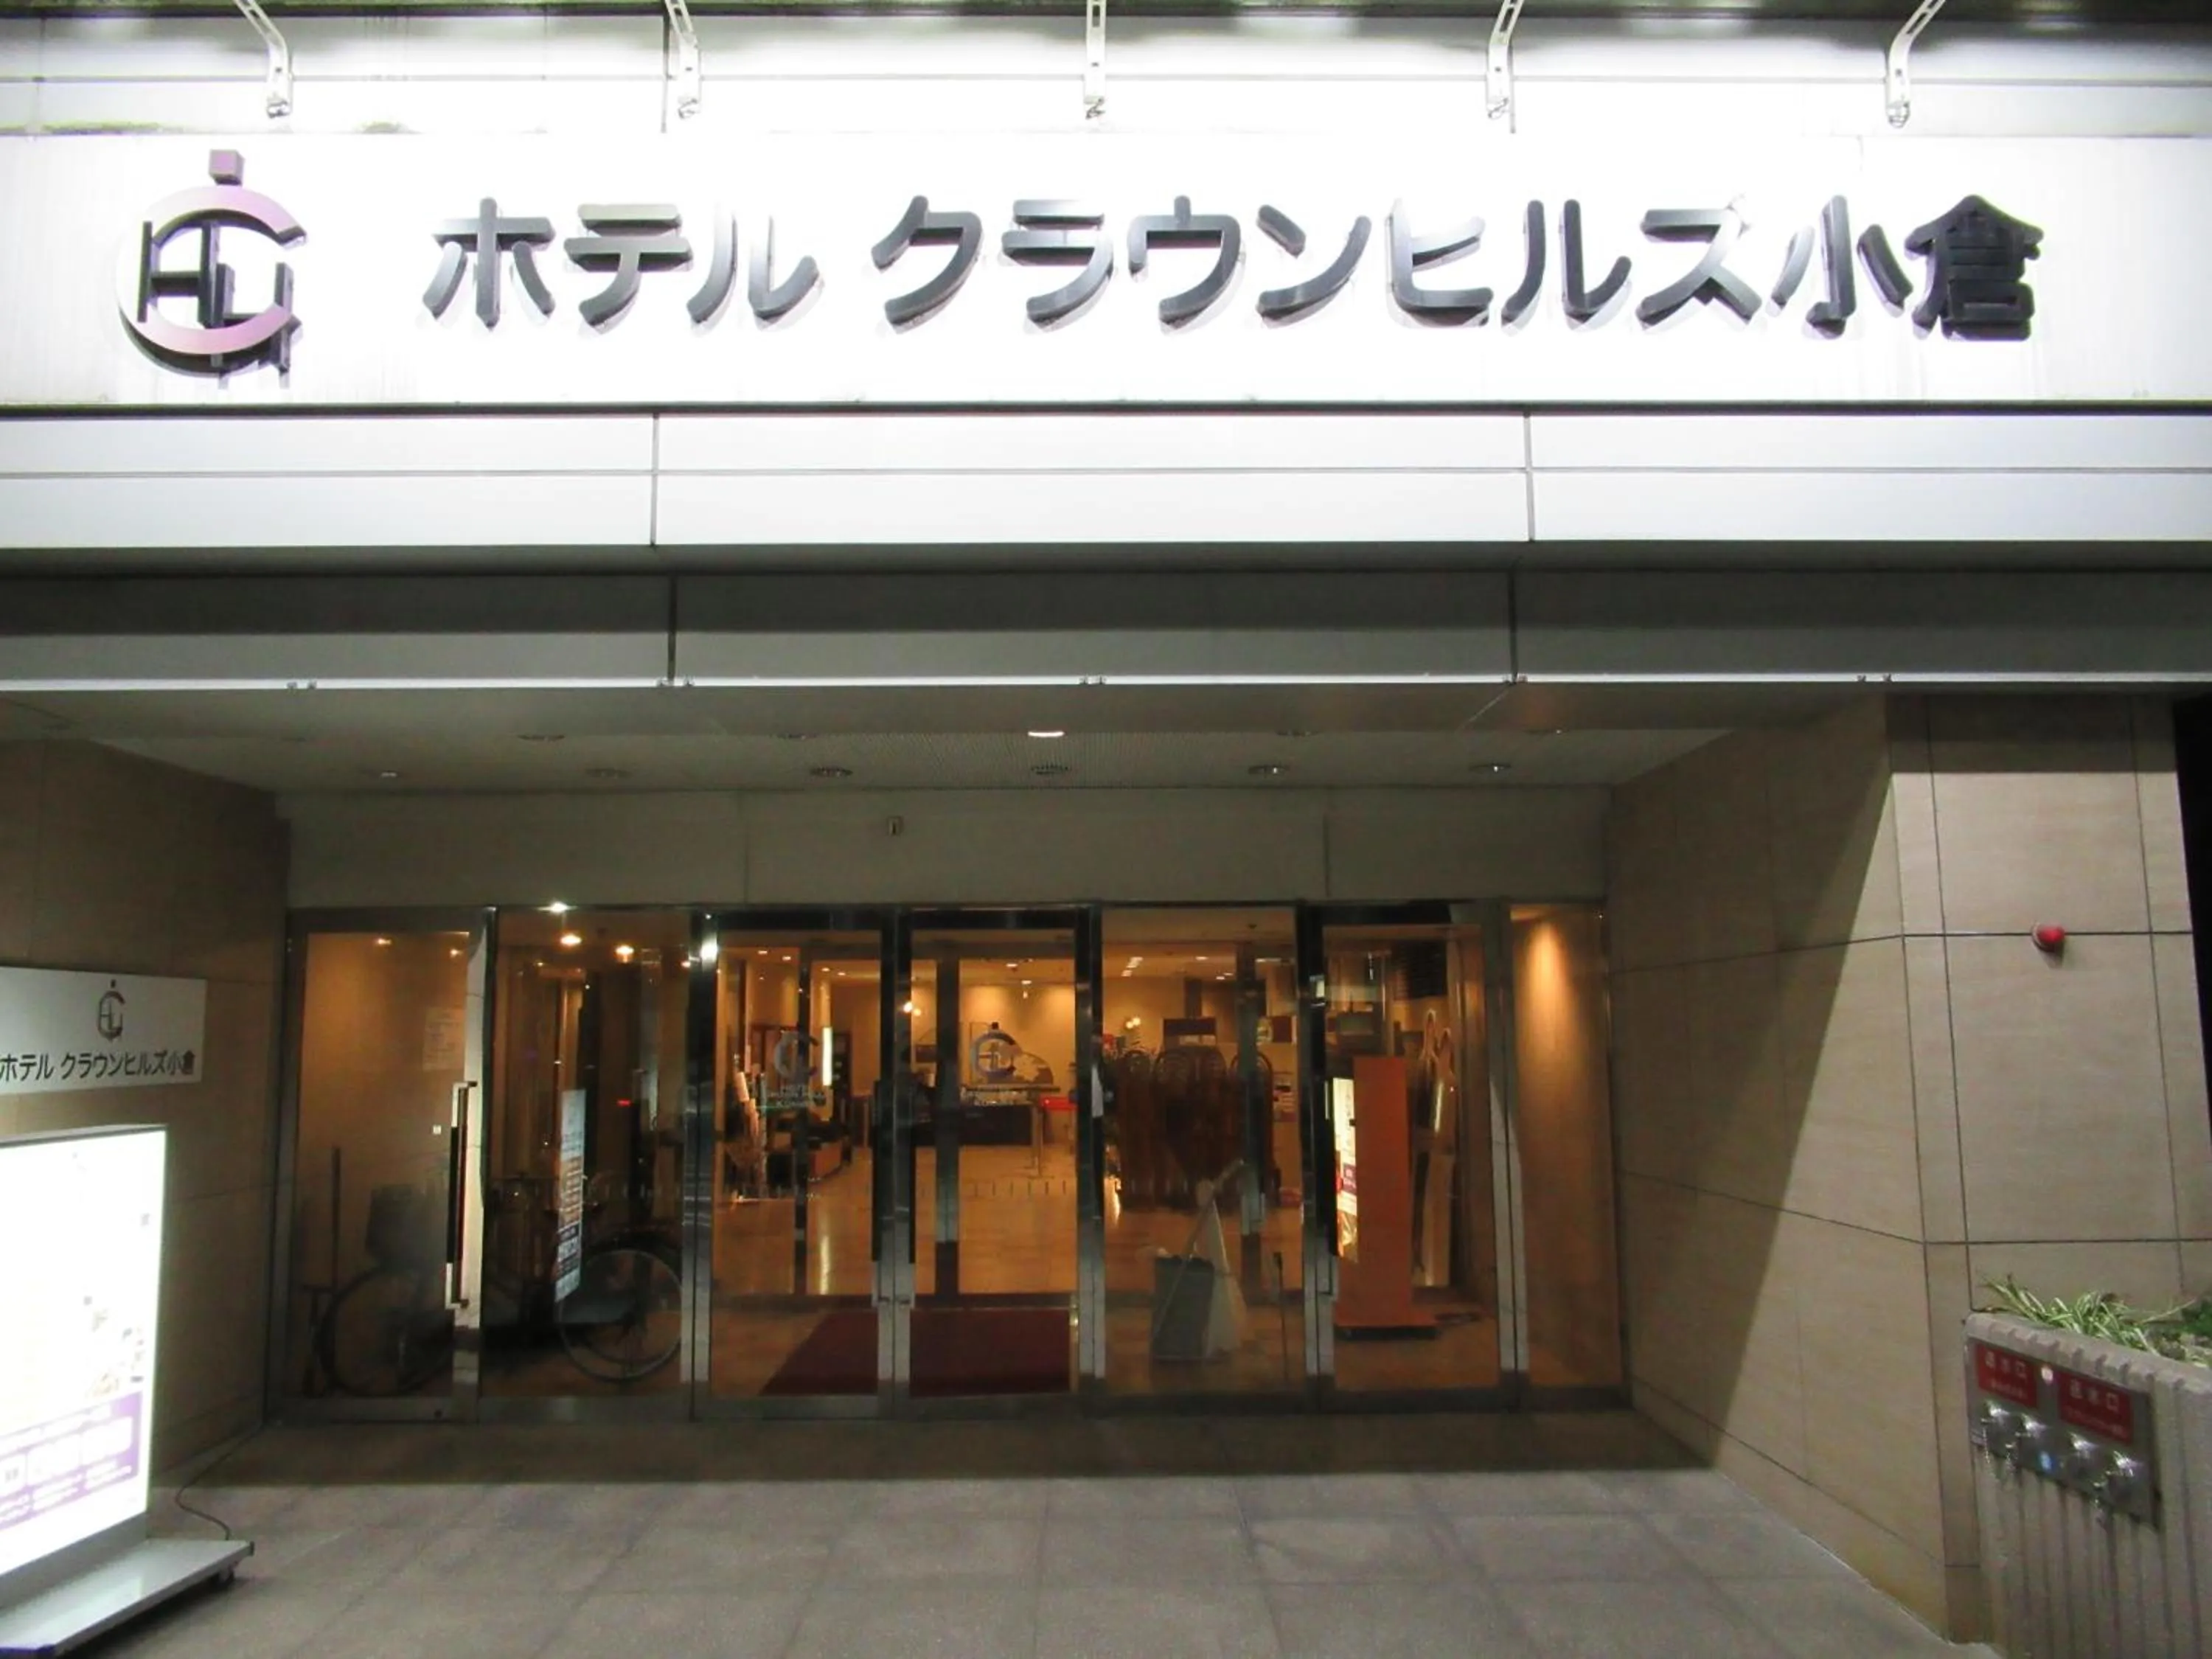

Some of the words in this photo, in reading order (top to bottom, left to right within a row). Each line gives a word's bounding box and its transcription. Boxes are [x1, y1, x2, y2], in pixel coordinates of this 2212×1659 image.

[422, 196, 824, 332] ホテル
[873, 193, 2044, 342] クラウンヒルズ小倉
[0, 1051, 55, 1082] ホテル
